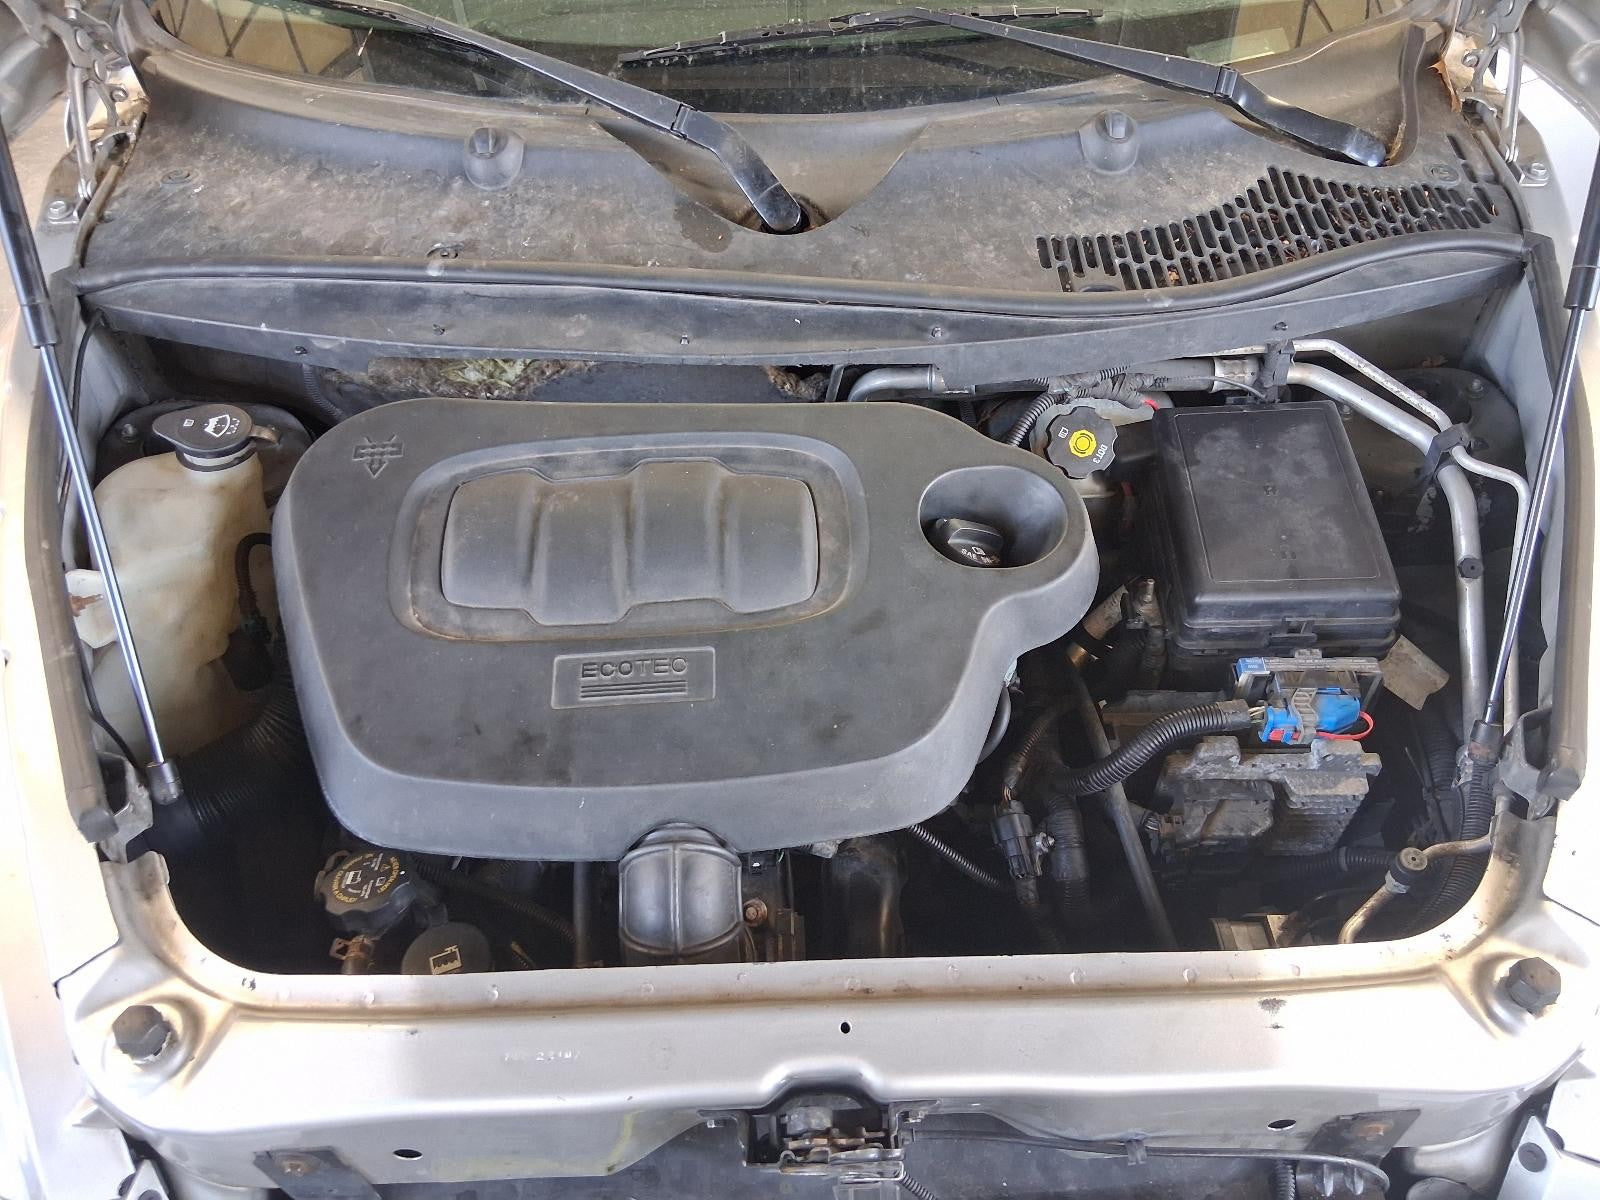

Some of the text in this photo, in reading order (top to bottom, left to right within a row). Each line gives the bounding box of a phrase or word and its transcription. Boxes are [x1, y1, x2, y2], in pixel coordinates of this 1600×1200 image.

[1097, 443, 1108, 461] DOT
[961, 548, 977, 560] SAE
[580, 657, 688, 679] ECOTEC
